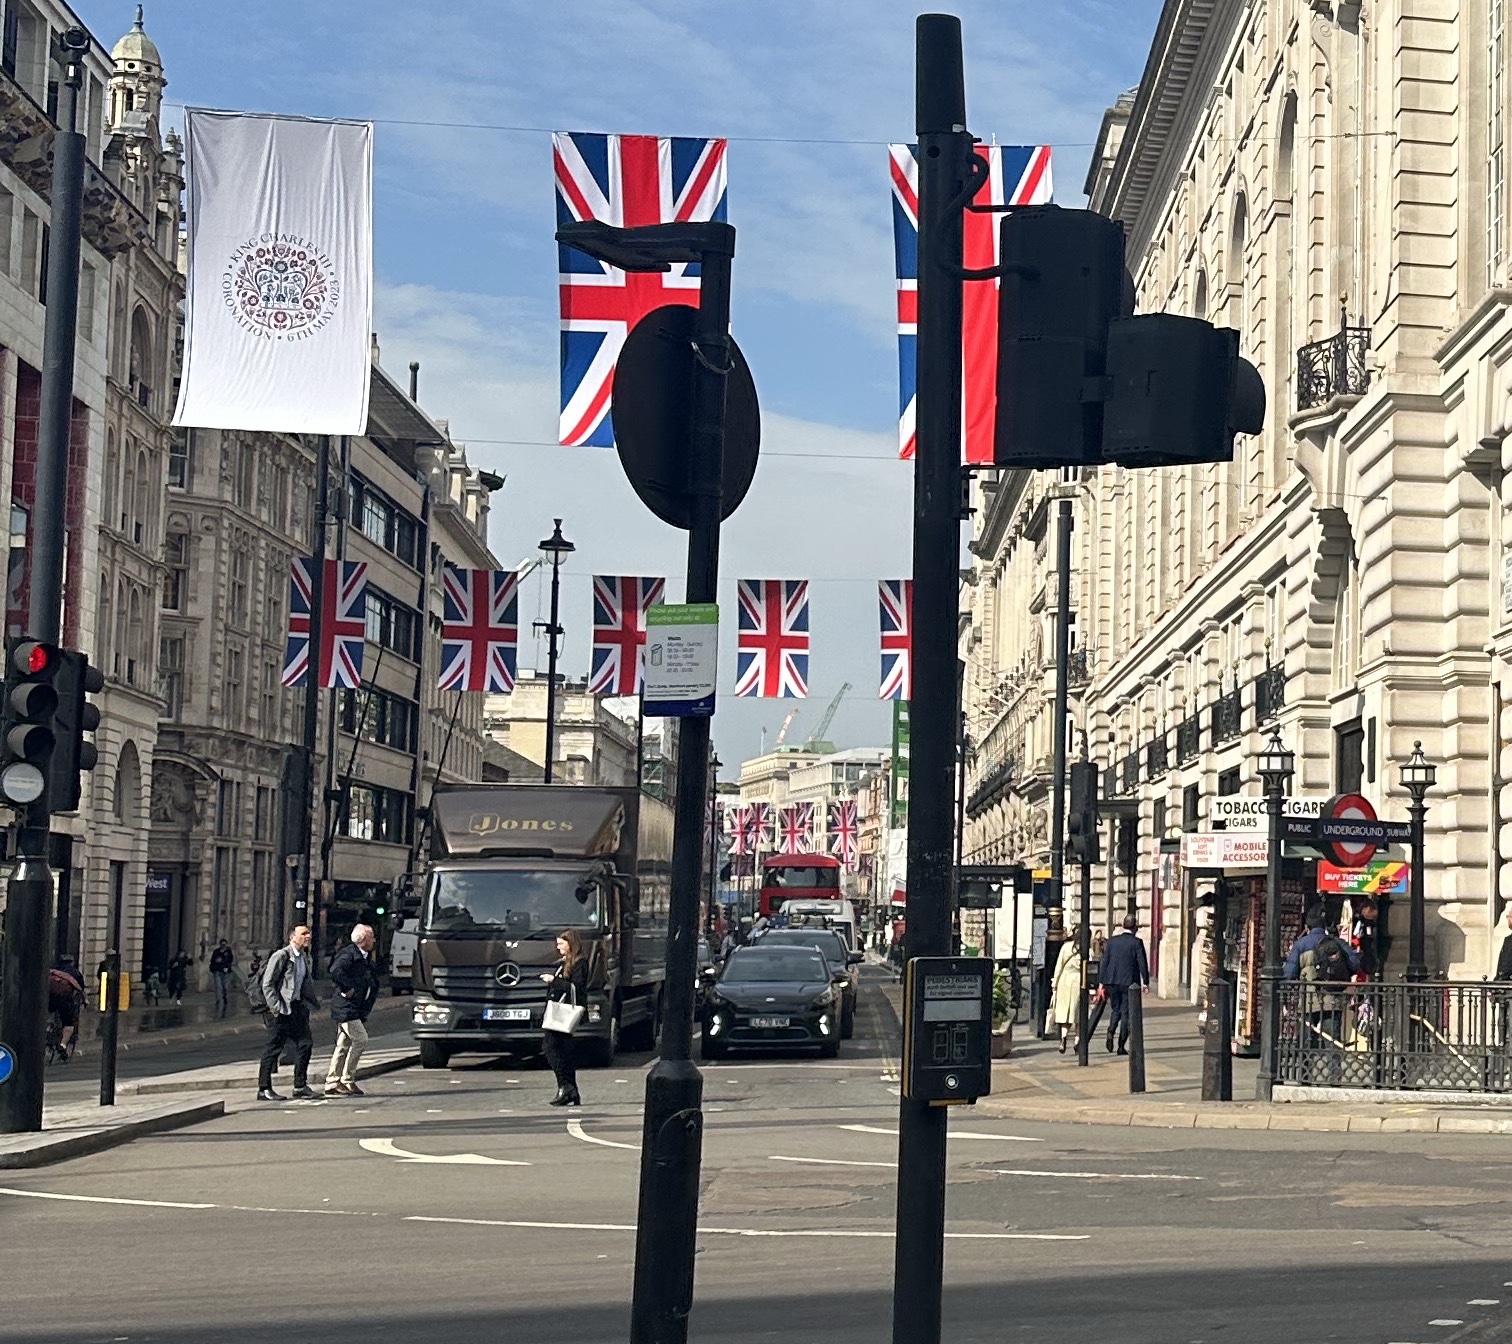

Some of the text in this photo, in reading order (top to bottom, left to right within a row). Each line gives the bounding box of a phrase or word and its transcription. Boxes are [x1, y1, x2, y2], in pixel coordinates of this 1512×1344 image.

[230, 232, 333, 269] KING CHARLES III
[222, 272, 271, 340] CORONATION
[287, 279, 340, 342] 6TH MAY 2023
[1216, 801, 1270, 815] TOBACC
[473, 815, 574, 832] Jones
[1288, 823, 1312, 834] PUBLIC
[1323, 824, 1384, 837] UNDERGROUND
[1234, 842, 1267, 851] MOBILE
[1324, 873, 1373, 882] BUY TICKETS
